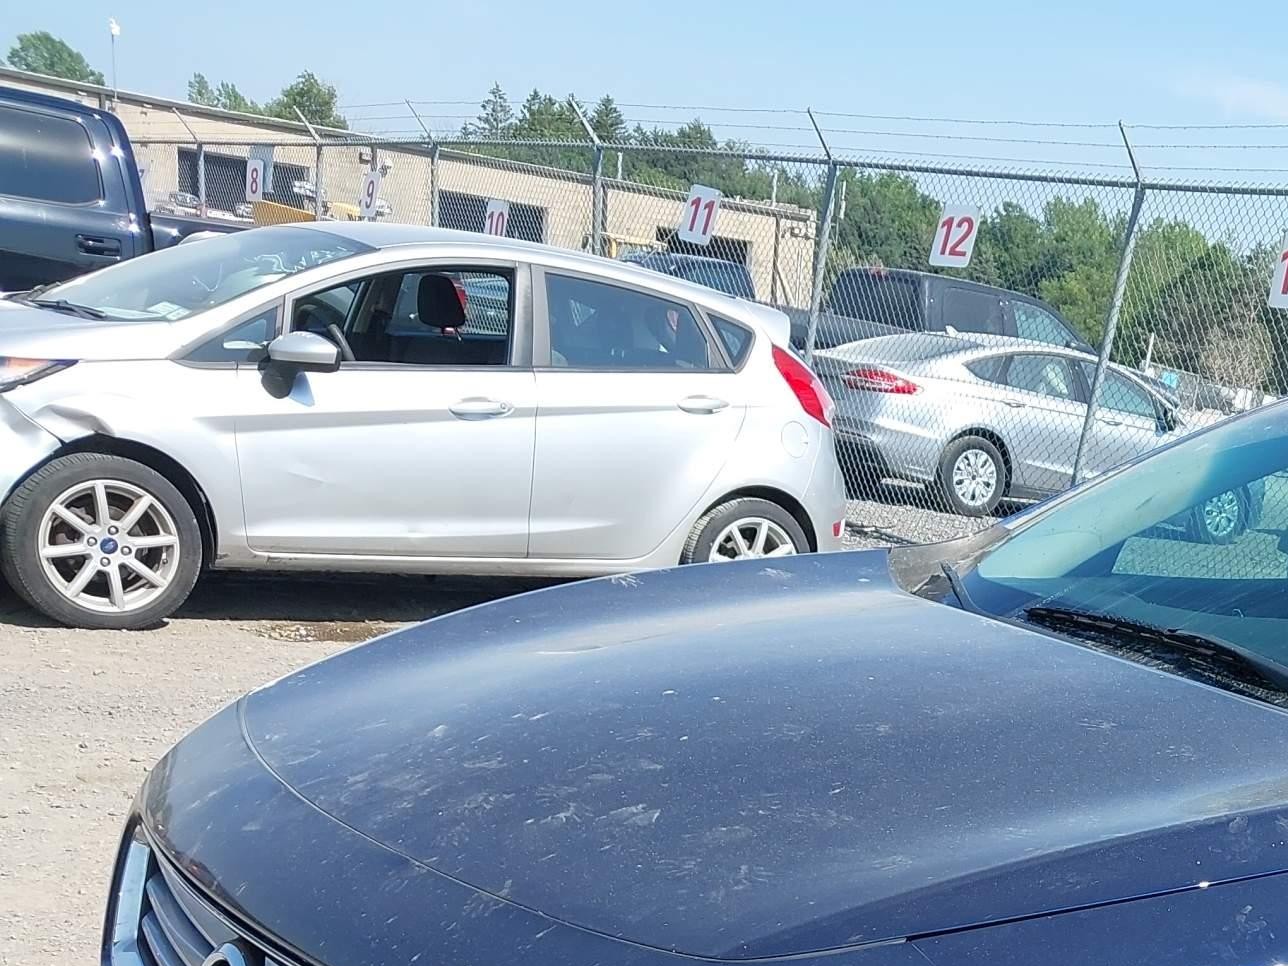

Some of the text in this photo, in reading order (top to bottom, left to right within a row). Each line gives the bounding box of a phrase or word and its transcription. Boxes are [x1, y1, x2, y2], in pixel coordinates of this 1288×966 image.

[250, 167, 258, 194] 8
[364, 180, 375, 209] 9
[487, 210, 505, 236] 10
[690, 196, 715, 236] 11
[940, 216, 974, 257] 12
